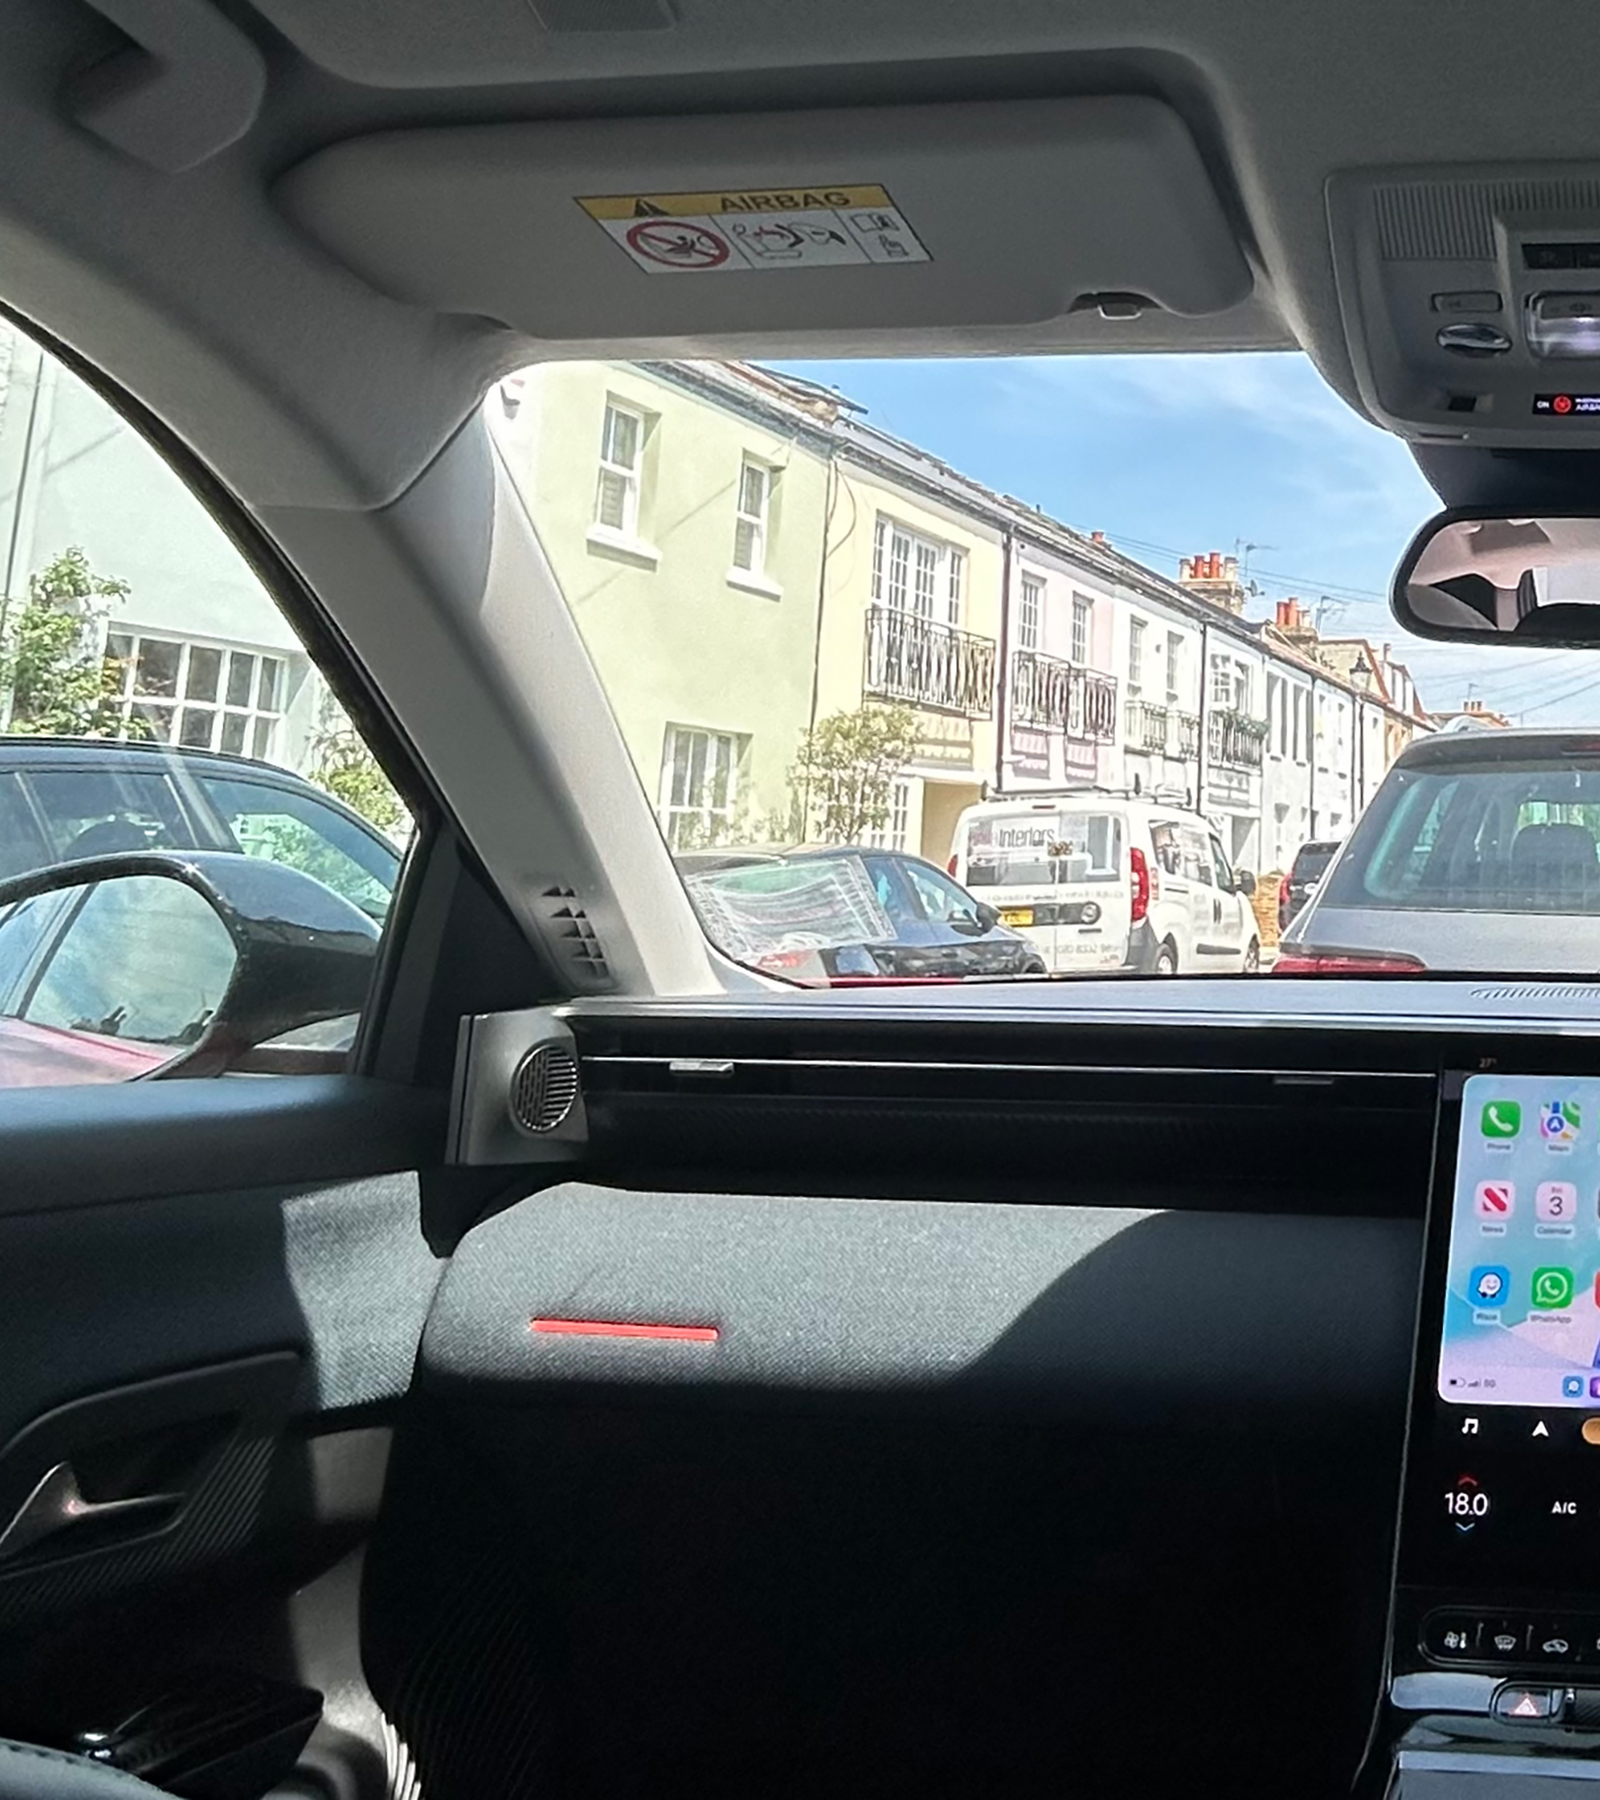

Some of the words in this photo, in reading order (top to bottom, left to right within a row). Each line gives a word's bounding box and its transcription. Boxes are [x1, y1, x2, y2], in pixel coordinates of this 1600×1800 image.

[721, 192, 850, 211] AIRBAG
[999, 827, 1054, 848] Interiors
[1549, 1196, 1563, 1216] 3
[1537, 1226, 1572, 1235] Calendar
[1530, 1315, 1572, 1324] WhatsApp
[1445, 1493, 1488, 1516] 18.0
[1552, 1502, 1577, 1514] A/C
